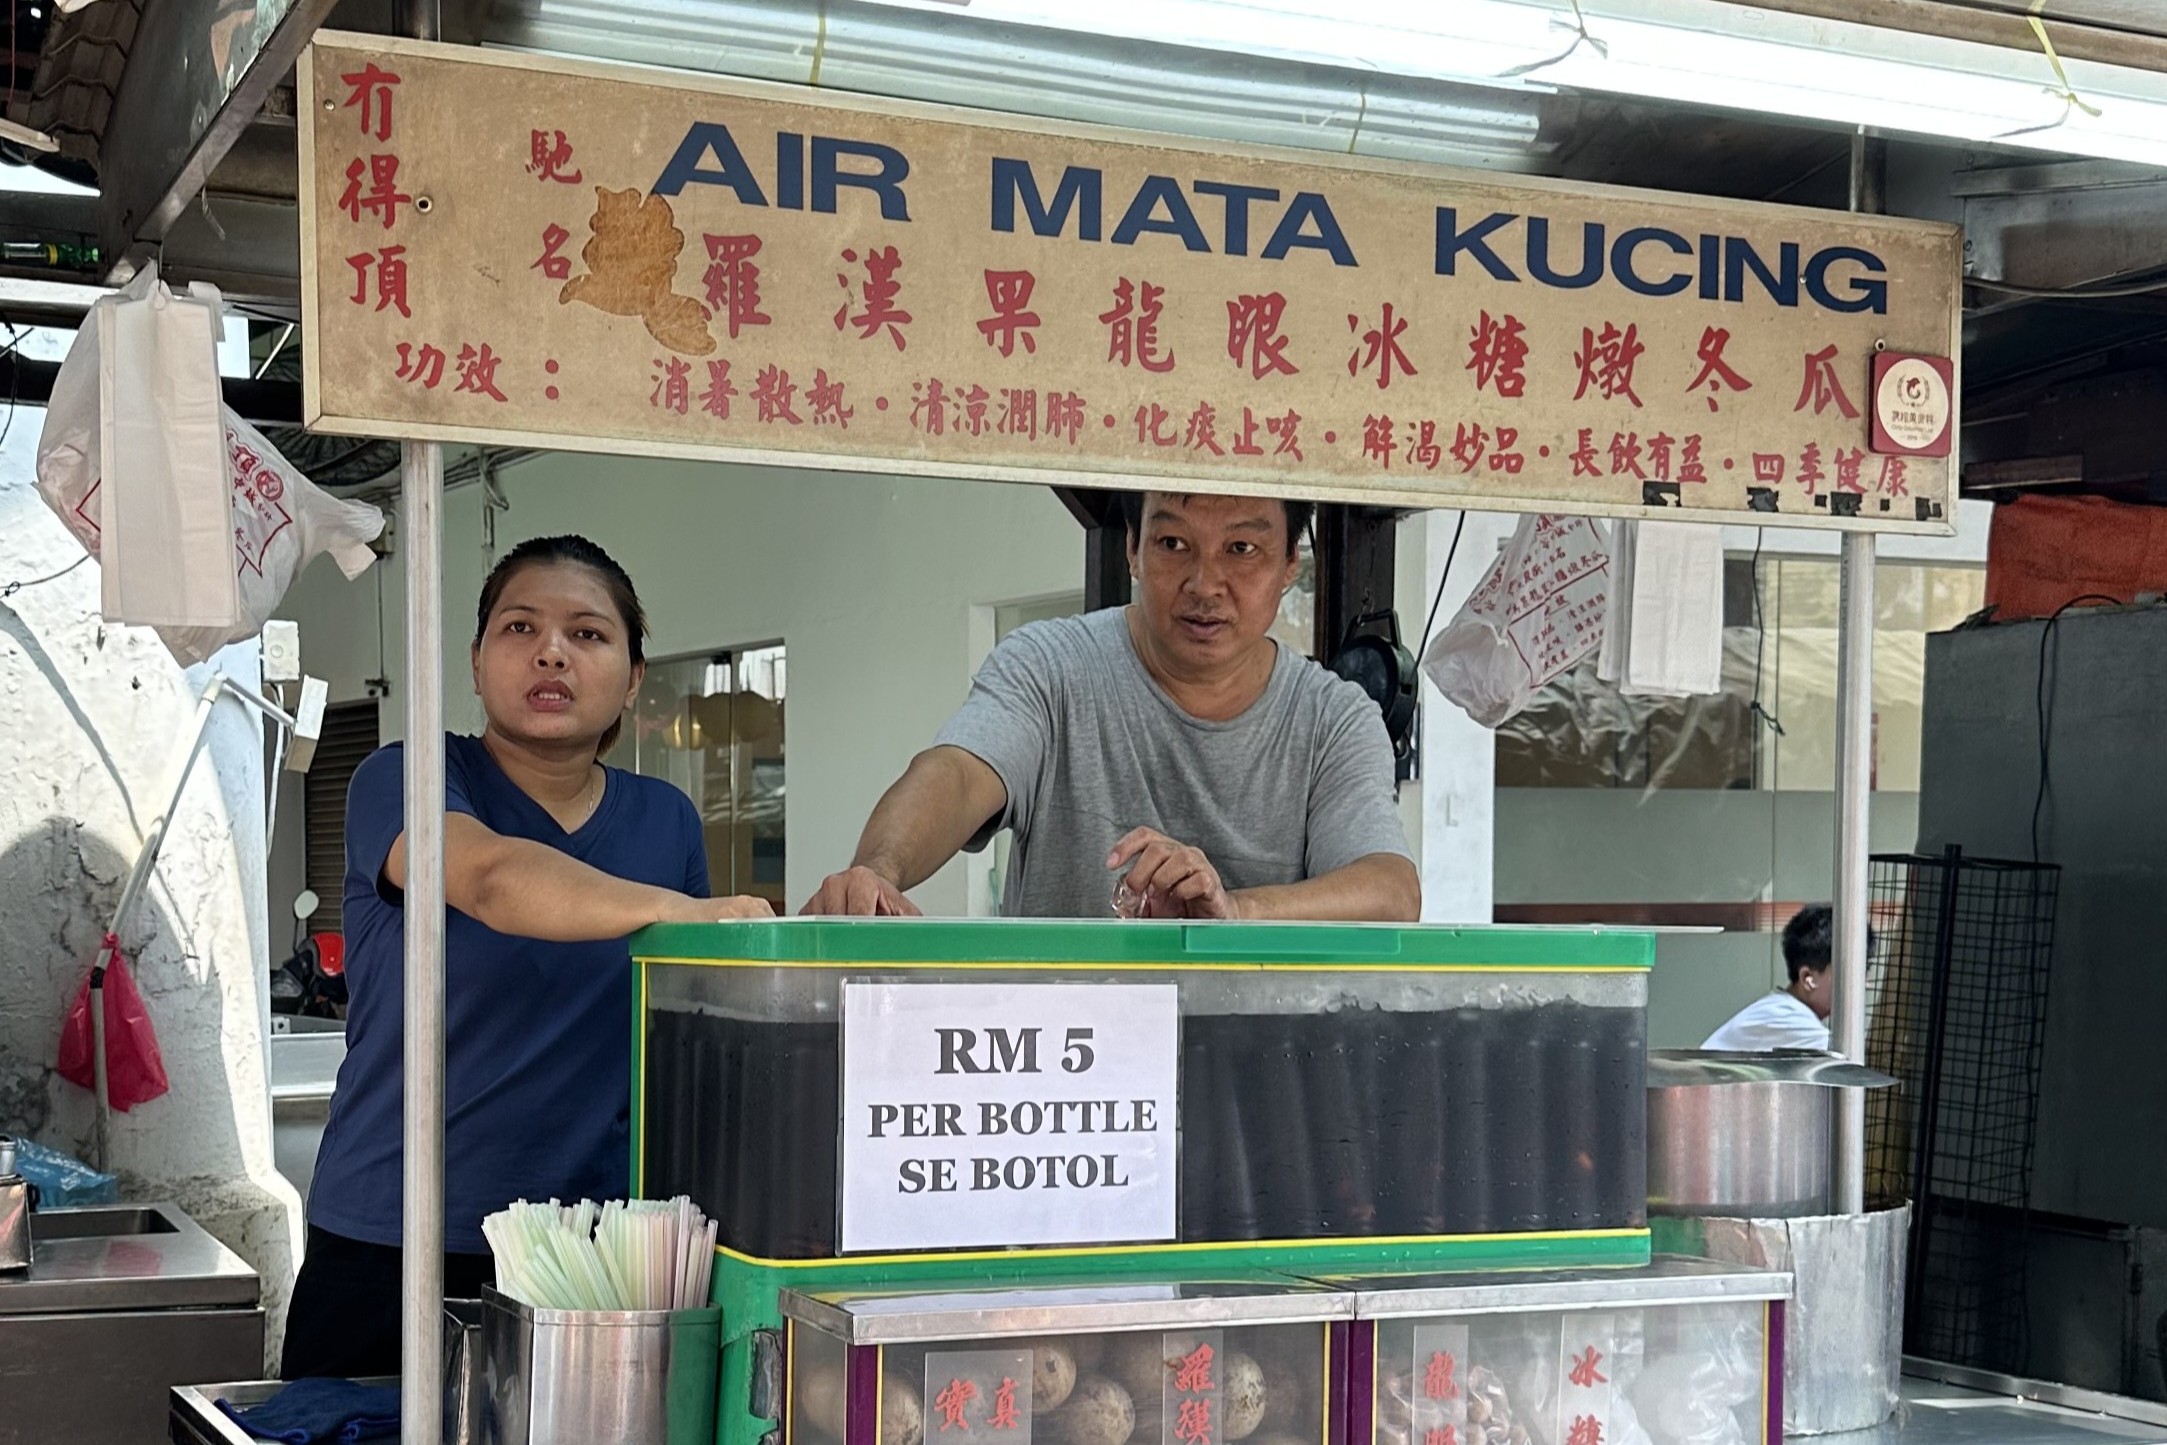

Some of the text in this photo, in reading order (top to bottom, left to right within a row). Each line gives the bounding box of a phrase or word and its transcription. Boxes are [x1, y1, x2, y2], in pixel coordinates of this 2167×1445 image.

[338, 63, 412, 319] 冇得頂
[655, 121, 1887, 314] AIR MATA KUCING
[933, 1027, 1096, 1075] RM 5
[867, 1100, 1158, 1138] PER BOTTLE
[897, 1154, 1130, 1194] SE BOTOL
